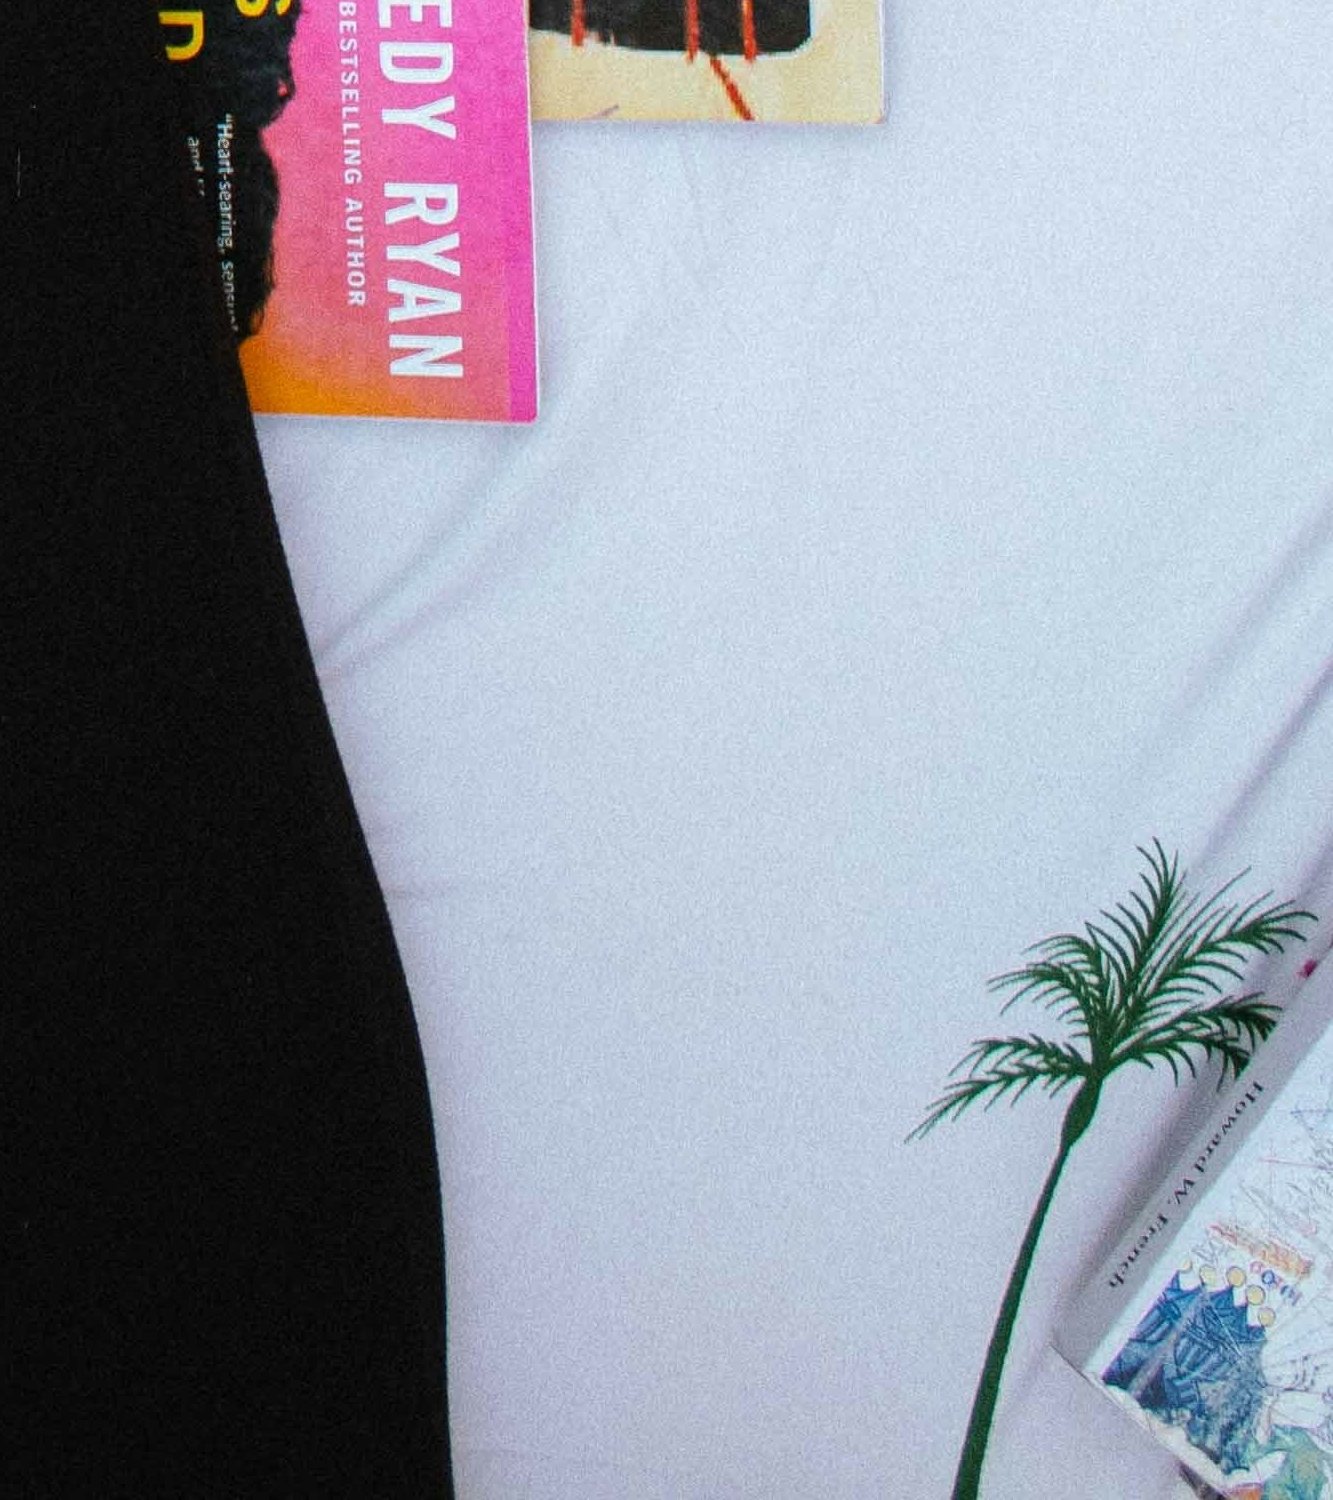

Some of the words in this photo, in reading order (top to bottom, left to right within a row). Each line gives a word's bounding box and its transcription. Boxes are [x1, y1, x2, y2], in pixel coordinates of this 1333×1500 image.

[339, 0, 363, 186] BESTSELLING
[343, 200, 366, 308] AUTHOR
[382, 180, 465, 380] RYAN
[1192, 1081, 1265, 1177] Howard
[1106, 1212, 1170, 1290] French
